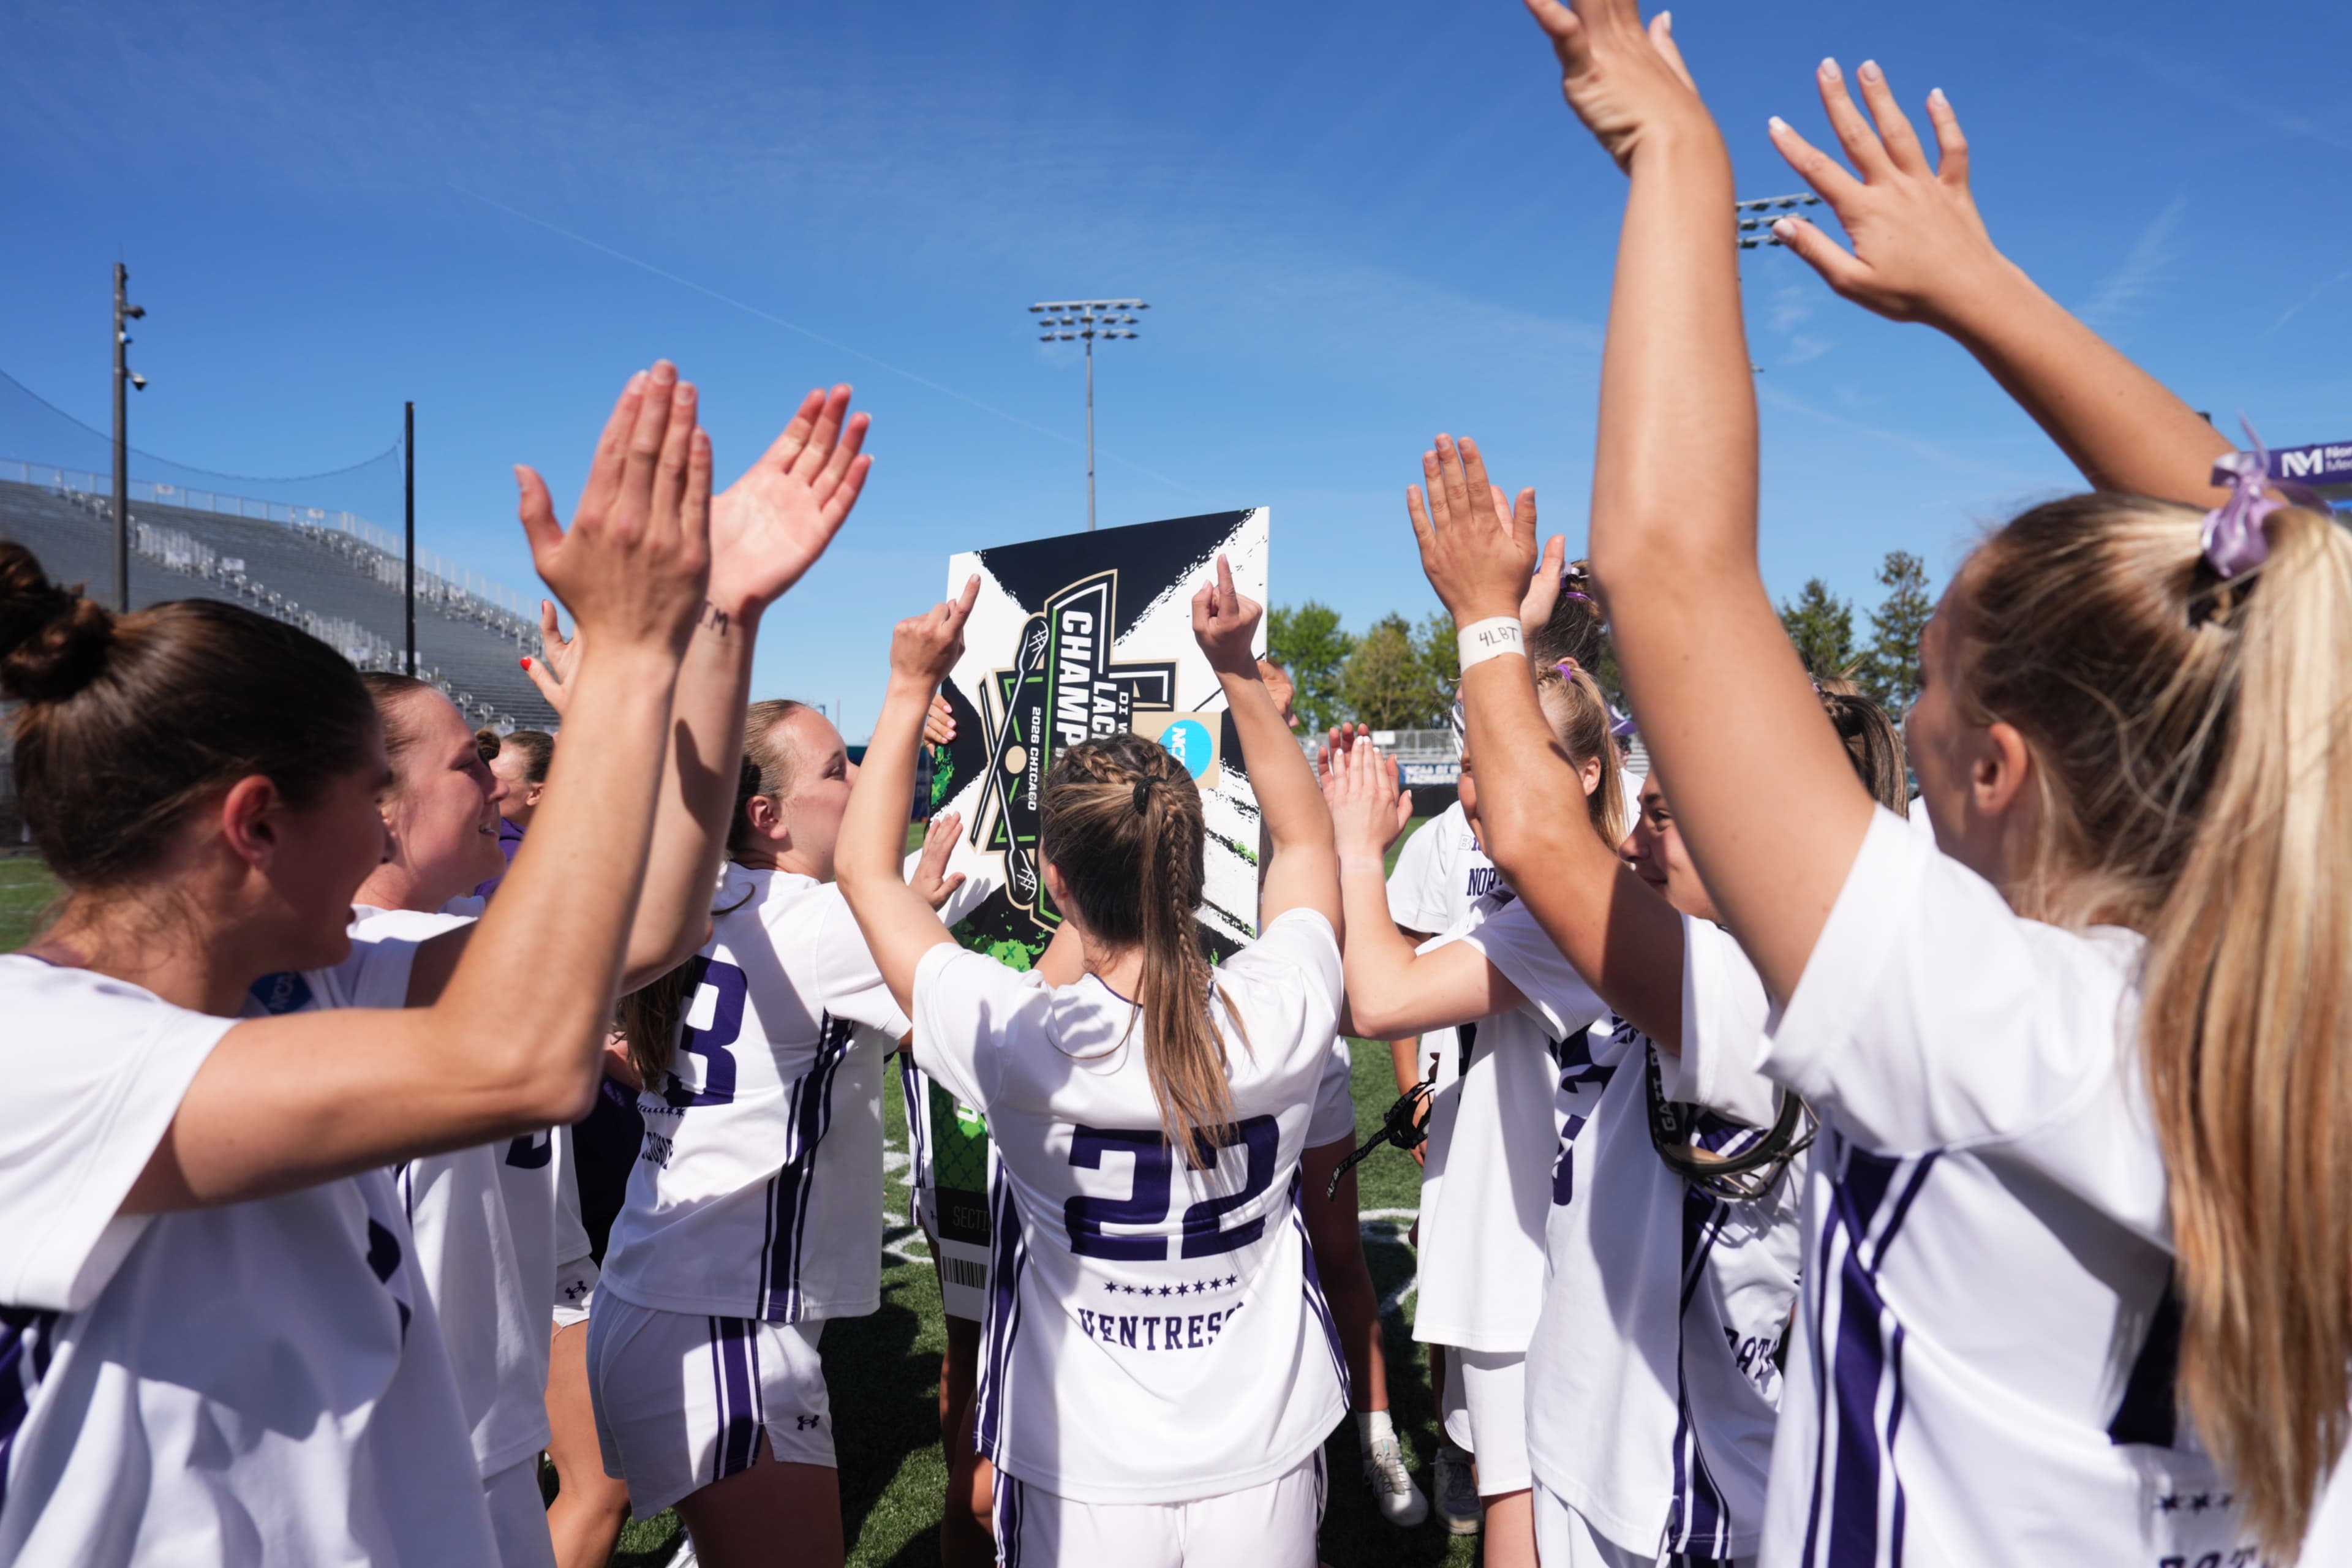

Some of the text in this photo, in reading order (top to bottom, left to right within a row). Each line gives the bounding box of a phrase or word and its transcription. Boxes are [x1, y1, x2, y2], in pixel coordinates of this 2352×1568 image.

[1479, 626, 1518, 647] 4LBT
[1055, 610, 1093, 758] CHAMP
[1091, 681, 1117, 740] LAC
[1028, 706, 1041, 811] 2026 CHICAGO
[1466, 867, 1502, 896] NOR
[1064, 1114, 1280, 1261] 22
